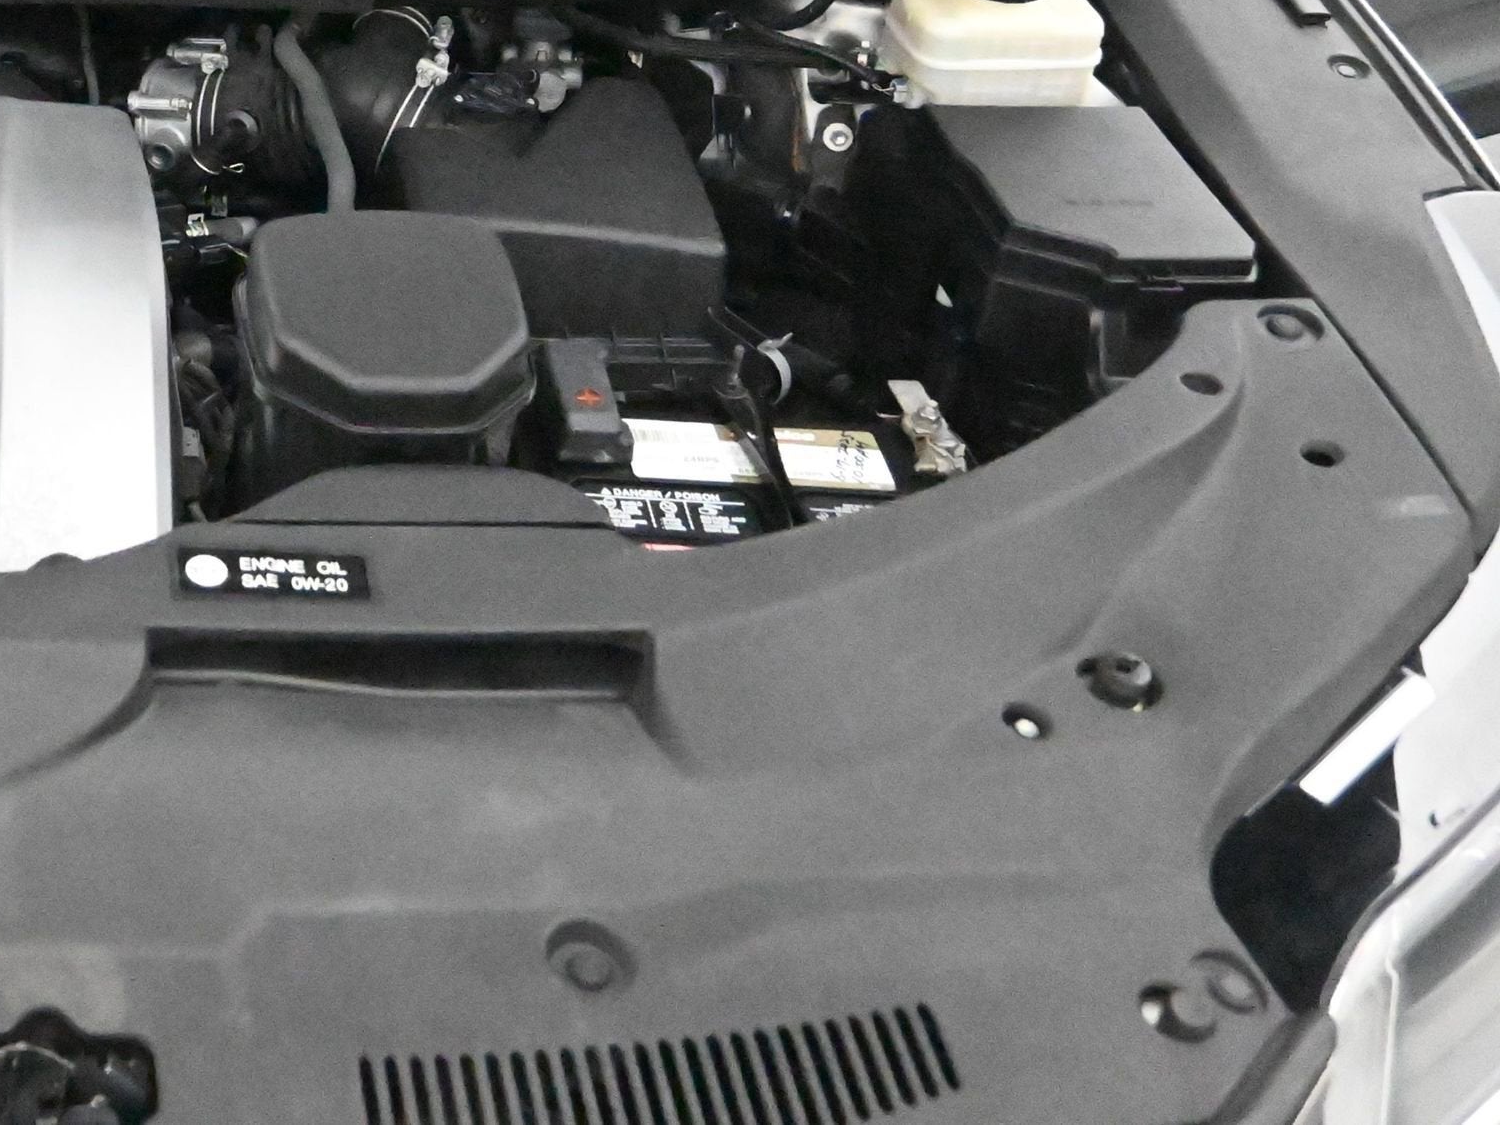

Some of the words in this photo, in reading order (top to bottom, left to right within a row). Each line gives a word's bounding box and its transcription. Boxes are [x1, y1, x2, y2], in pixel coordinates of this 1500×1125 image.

[612, 487, 663, 499] DANGER
[674, 491, 721, 502] POISON
[238, 556, 306, 574] ENGINE
[316, 560, 348, 576] OIL
[241, 573, 279, 588] SAE
[291, 576, 349, 592] 0W-20
